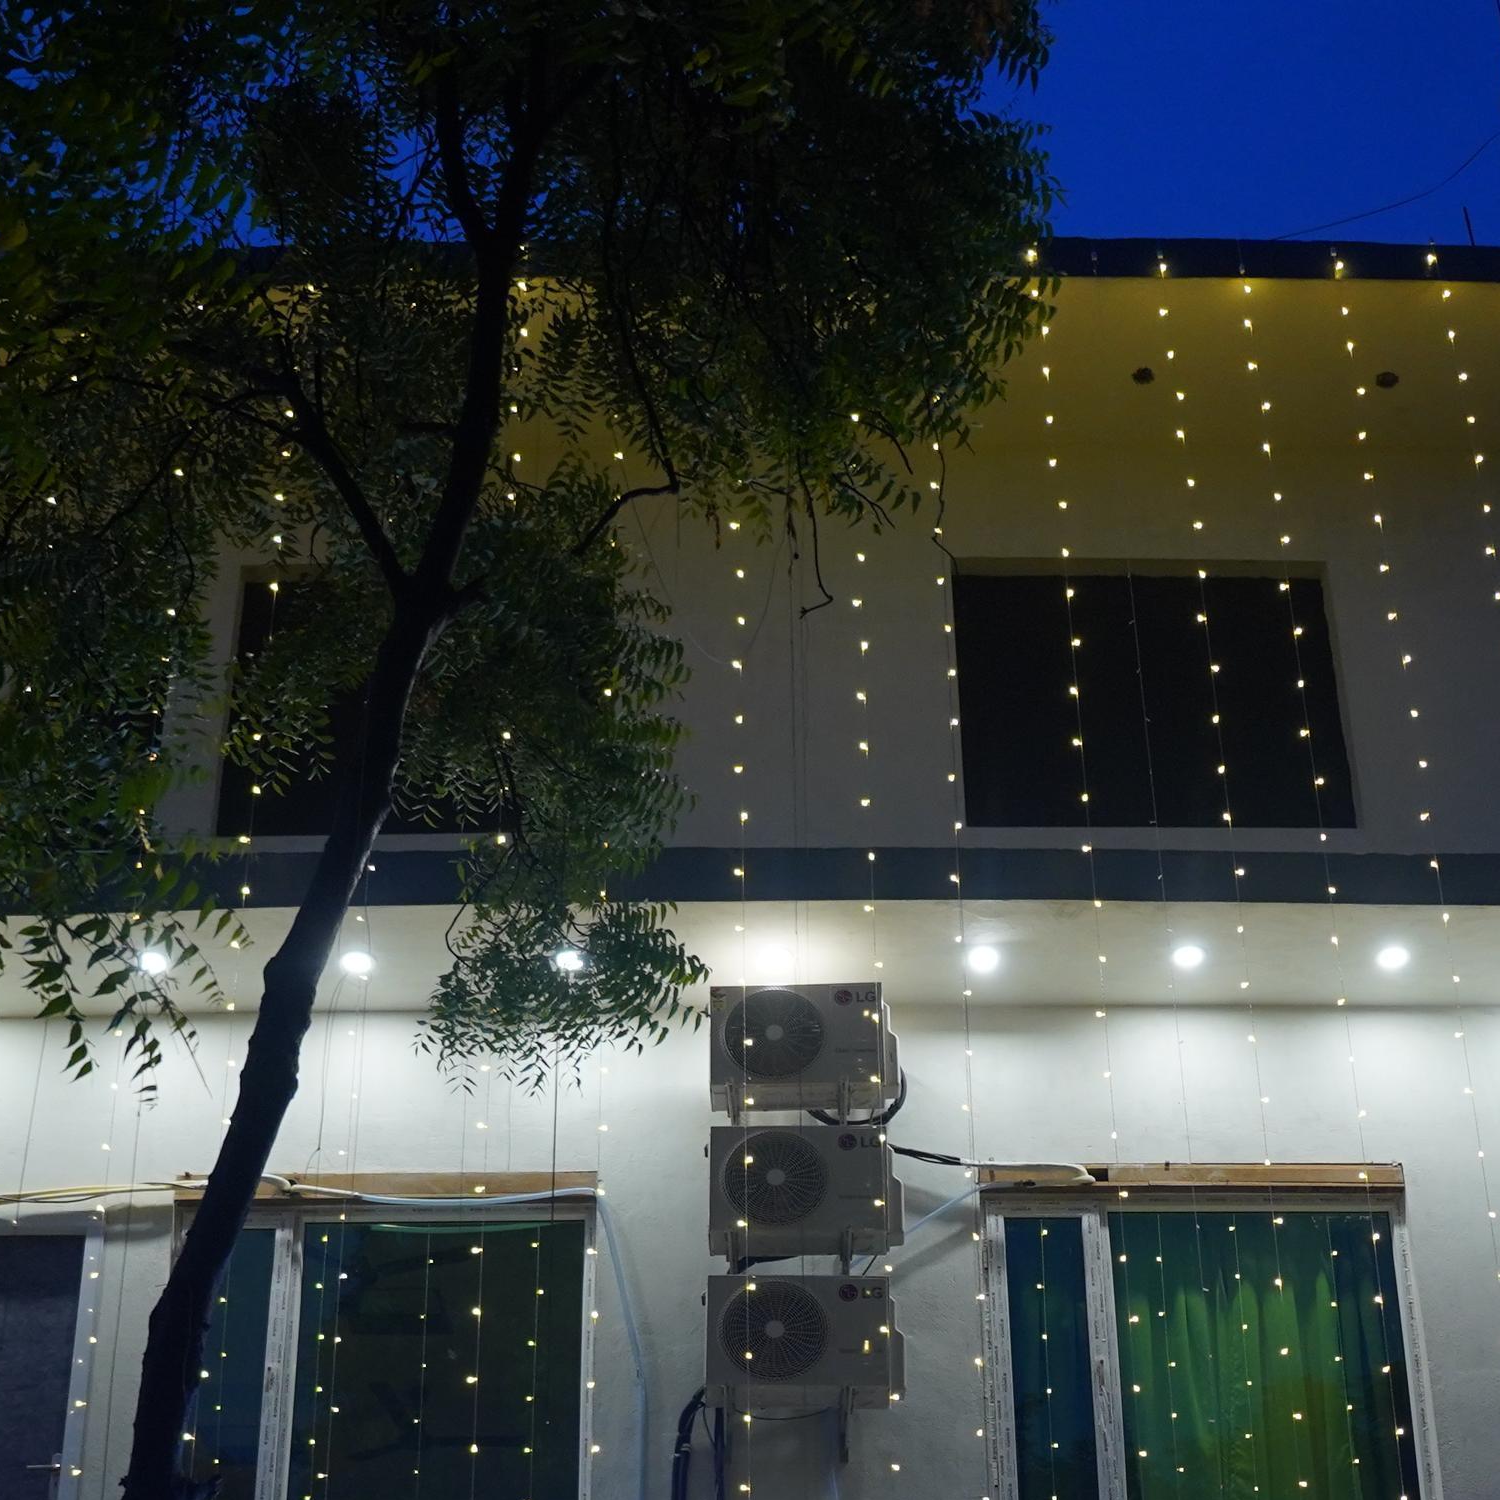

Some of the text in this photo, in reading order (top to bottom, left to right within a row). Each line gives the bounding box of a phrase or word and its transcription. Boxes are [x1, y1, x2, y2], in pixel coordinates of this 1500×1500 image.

[856, 991, 876, 1003] LG
[860, 1135, 881, 1148] LG
[861, 1286, 883, 1300] LG
